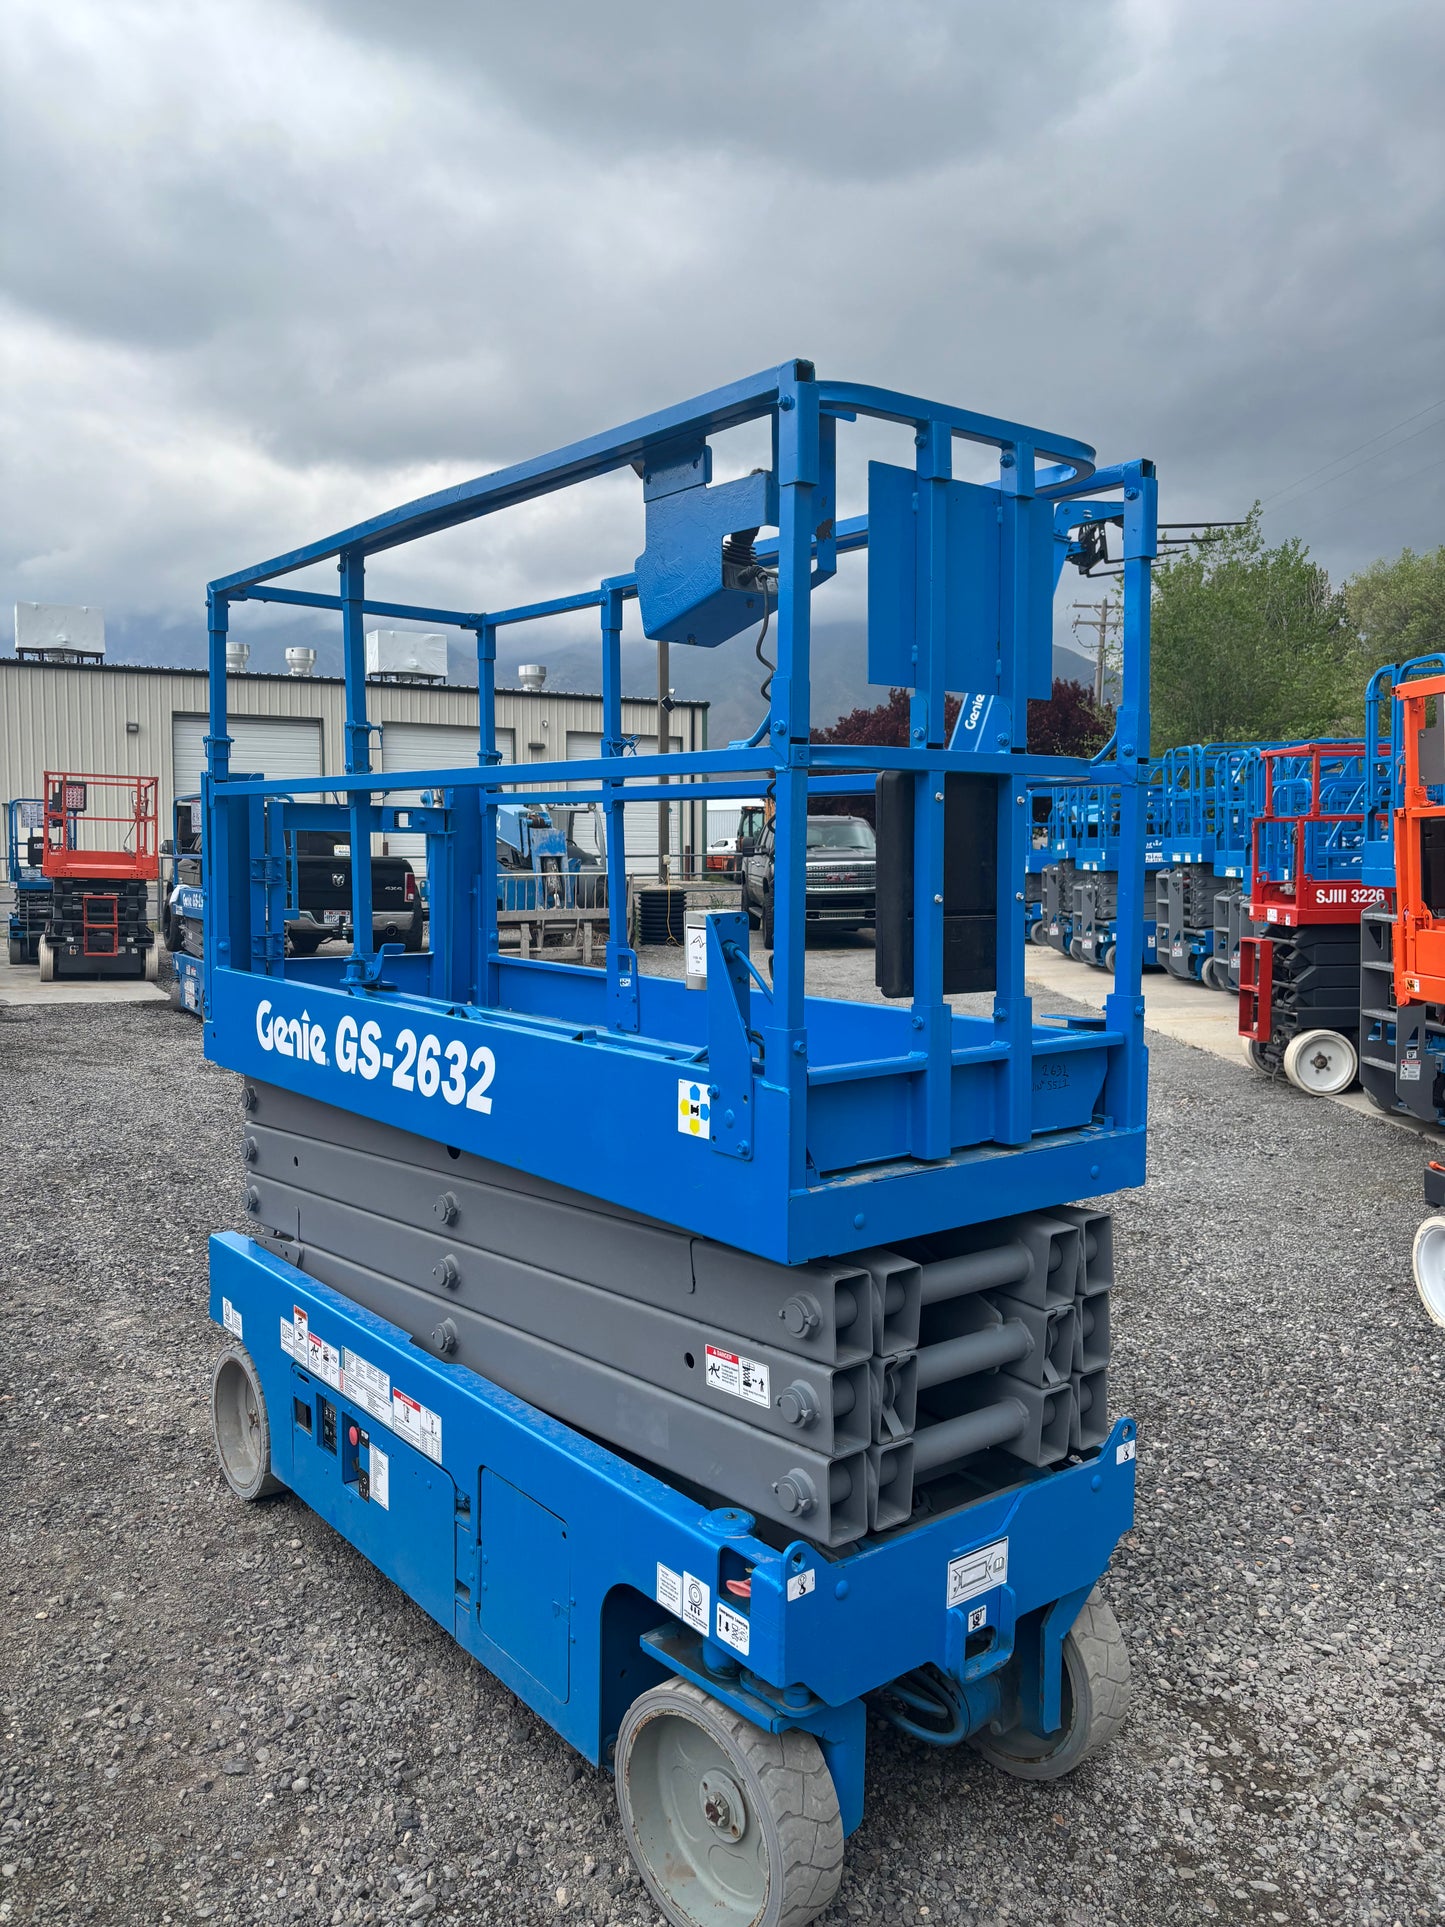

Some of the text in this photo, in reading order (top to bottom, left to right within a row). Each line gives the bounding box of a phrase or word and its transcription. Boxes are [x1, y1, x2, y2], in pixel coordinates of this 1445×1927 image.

[965, 694, 985, 730] Genie
[1316, 888, 1385, 903] SJIII 3226
[256, 1000, 495, 1114] Genie GS-2632
